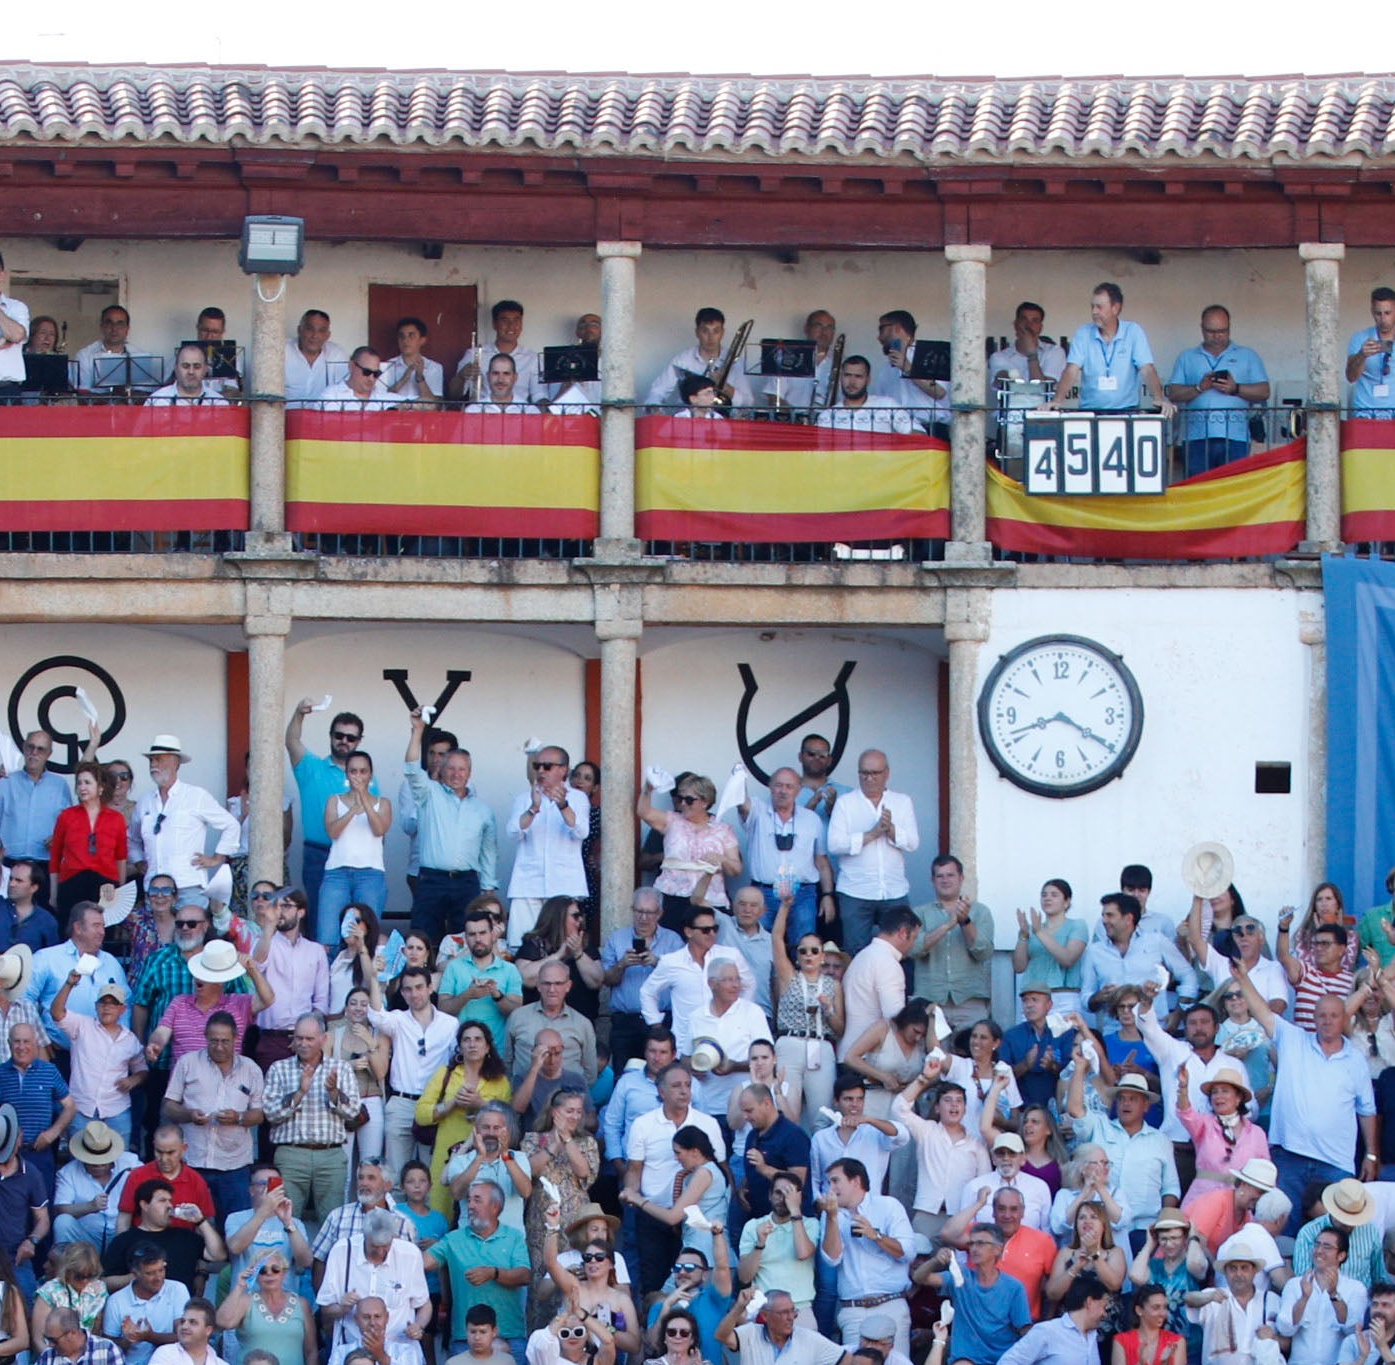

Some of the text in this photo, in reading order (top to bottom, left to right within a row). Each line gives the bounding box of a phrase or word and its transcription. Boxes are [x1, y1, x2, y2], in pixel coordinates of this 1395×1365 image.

[1052, 661, 1070, 680] 12
[1006, 706, 1017, 725] 9
[1105, 707, 1115, 725] 3
[1055, 750, 1065, 769] 6
